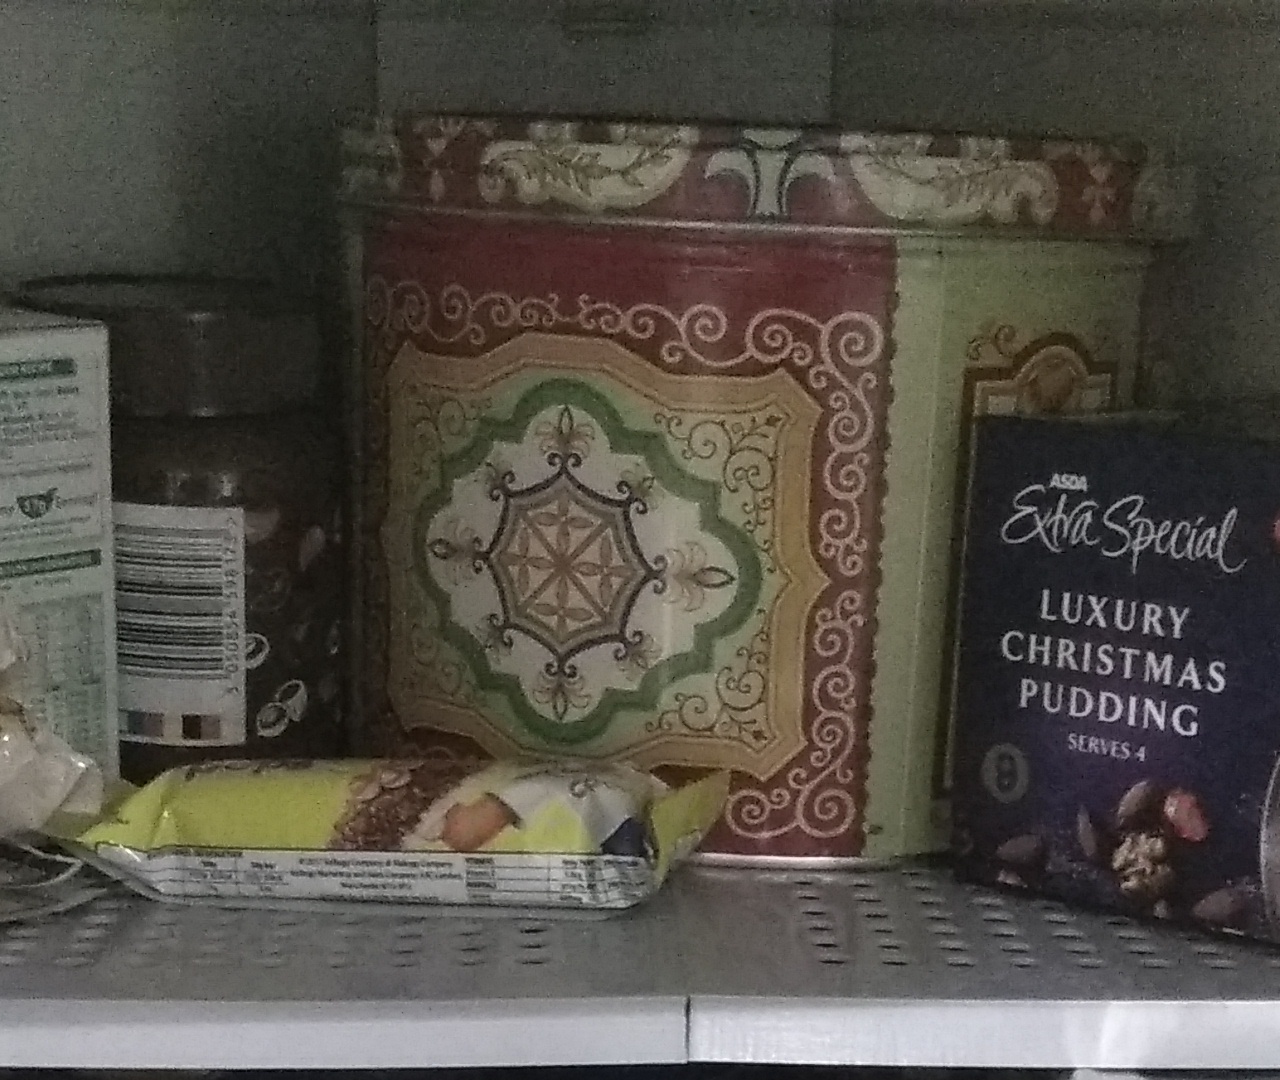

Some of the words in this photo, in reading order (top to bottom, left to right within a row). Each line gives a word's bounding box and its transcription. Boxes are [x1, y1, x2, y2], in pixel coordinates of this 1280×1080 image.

[1048, 472, 1089, 492] ASDA
[1000, 483, 1101, 554] Extra
[1100, 493, 1248, 575] Special
[1040, 587, 1191, 640] LUXURY
[1000, 630, 1228, 695] CHRISTMAS
[1017, 678, 1201, 738] PUDDING
[1066, 732, 1132, 762] SERVES
[1135, 745, 1148, 763] 4
